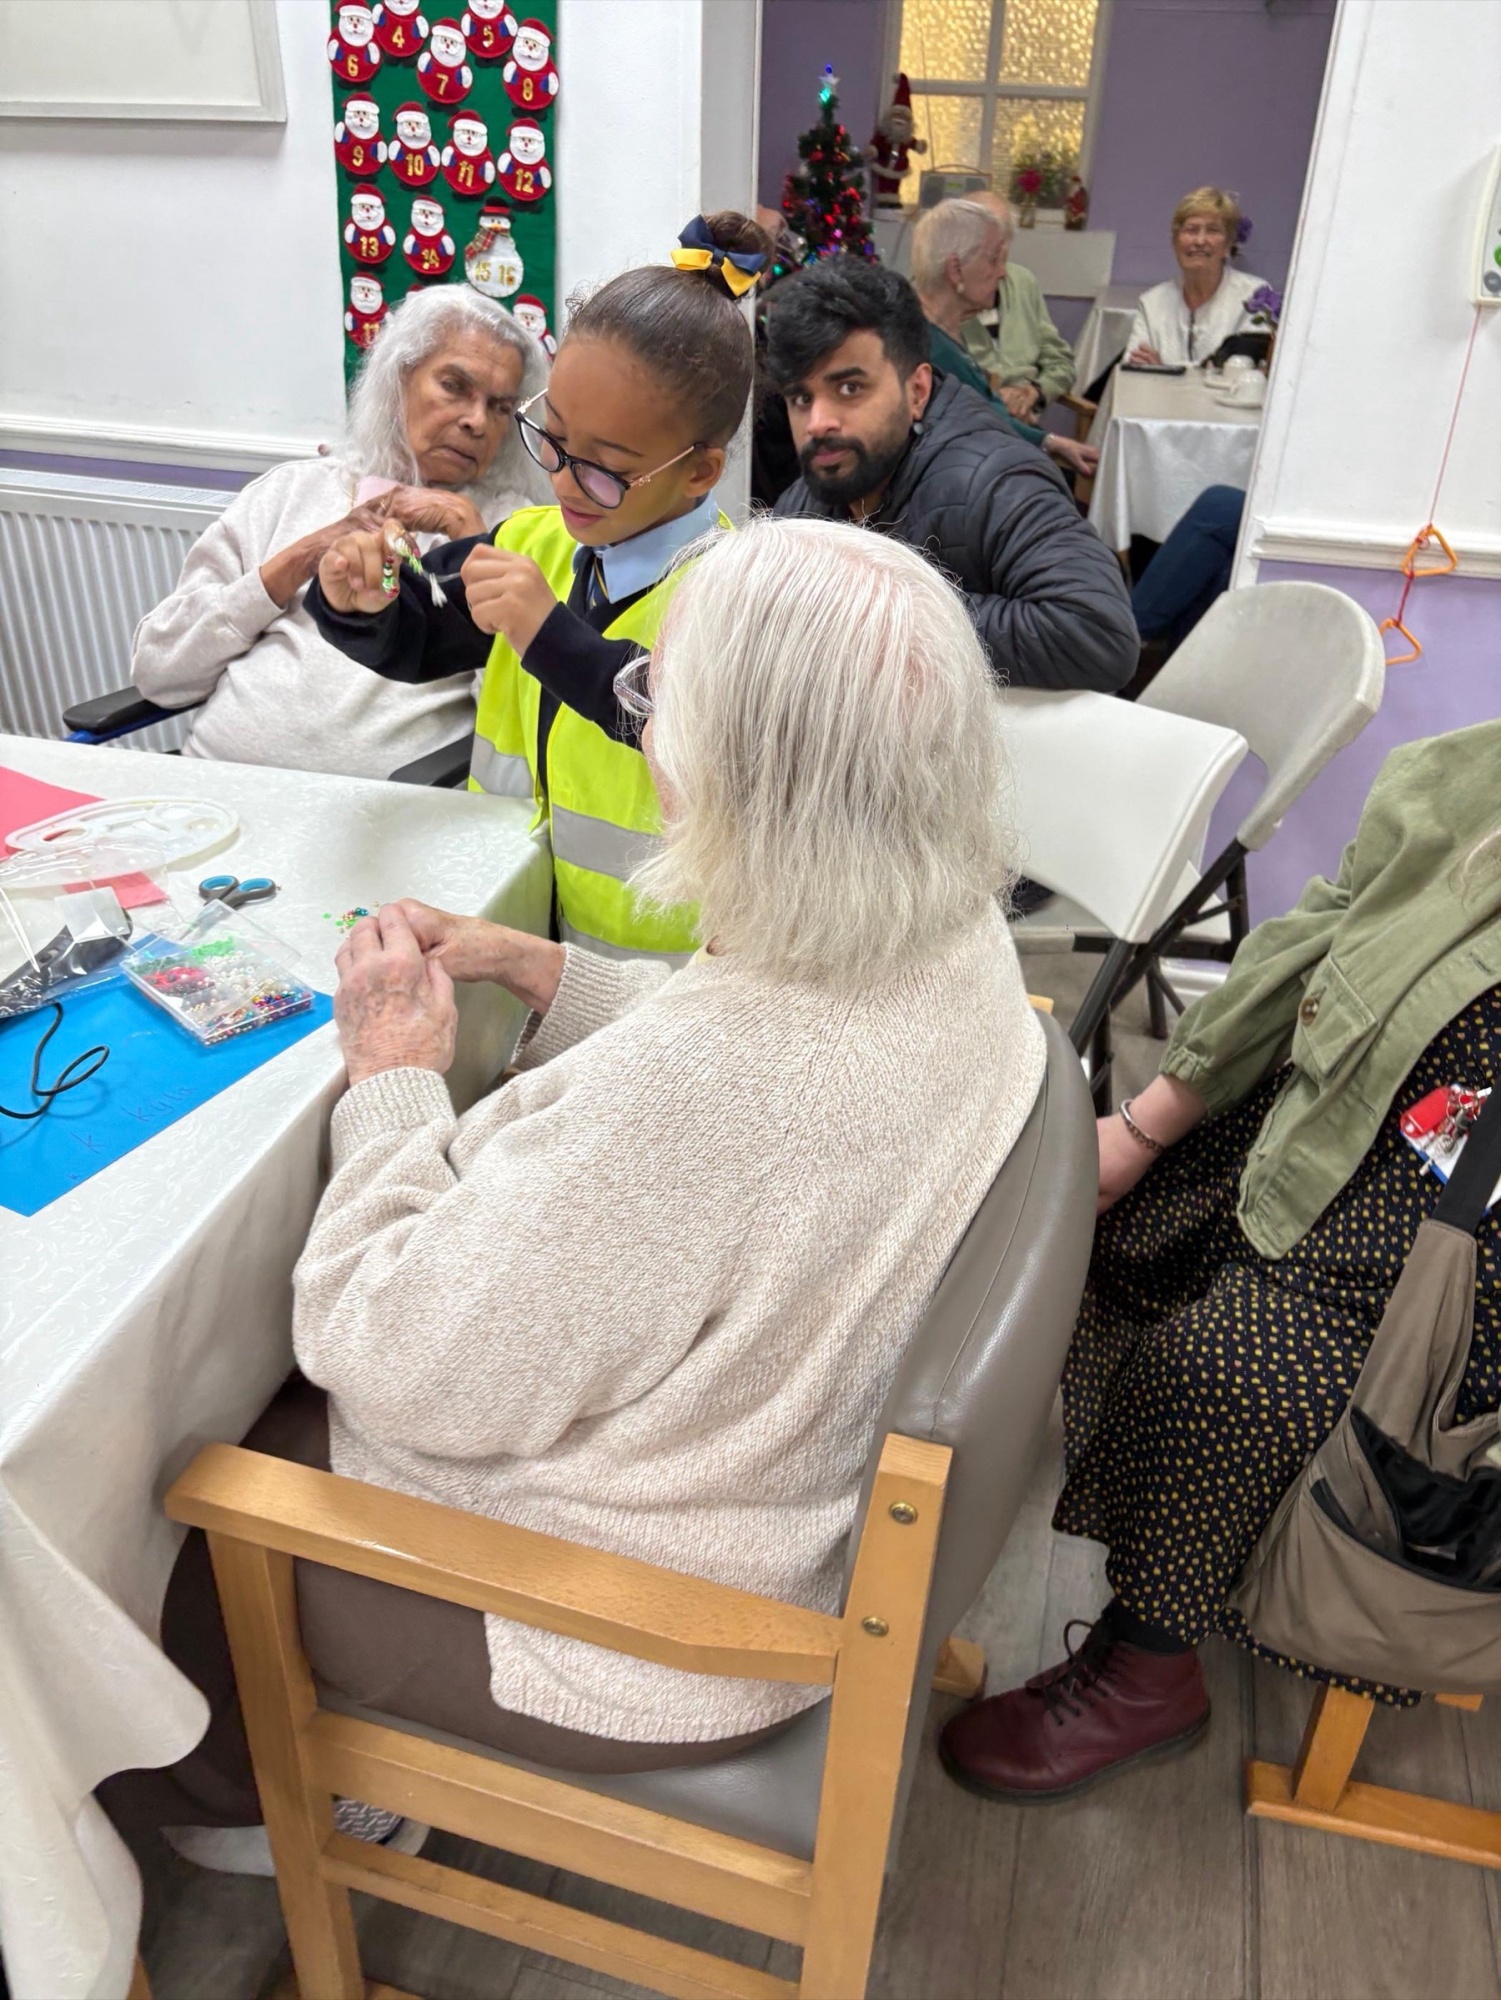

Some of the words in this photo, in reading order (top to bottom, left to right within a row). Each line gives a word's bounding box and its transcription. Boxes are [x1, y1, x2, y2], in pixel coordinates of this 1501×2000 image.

[392, 25, 405, 48] 4
[482, 26, 494, 47] 5
[347, 54, 358, 77] 6
[436, 73, 449, 95] 7
[522, 78, 534, 101] 8
[352, 146, 364, 167] 9
[405, 153, 425, 176] 10
[458, 160, 475, 187] 11
[515, 168, 535, 194] 12
[360, 236, 380, 257] 13
[421, 248, 440, 270] 14
